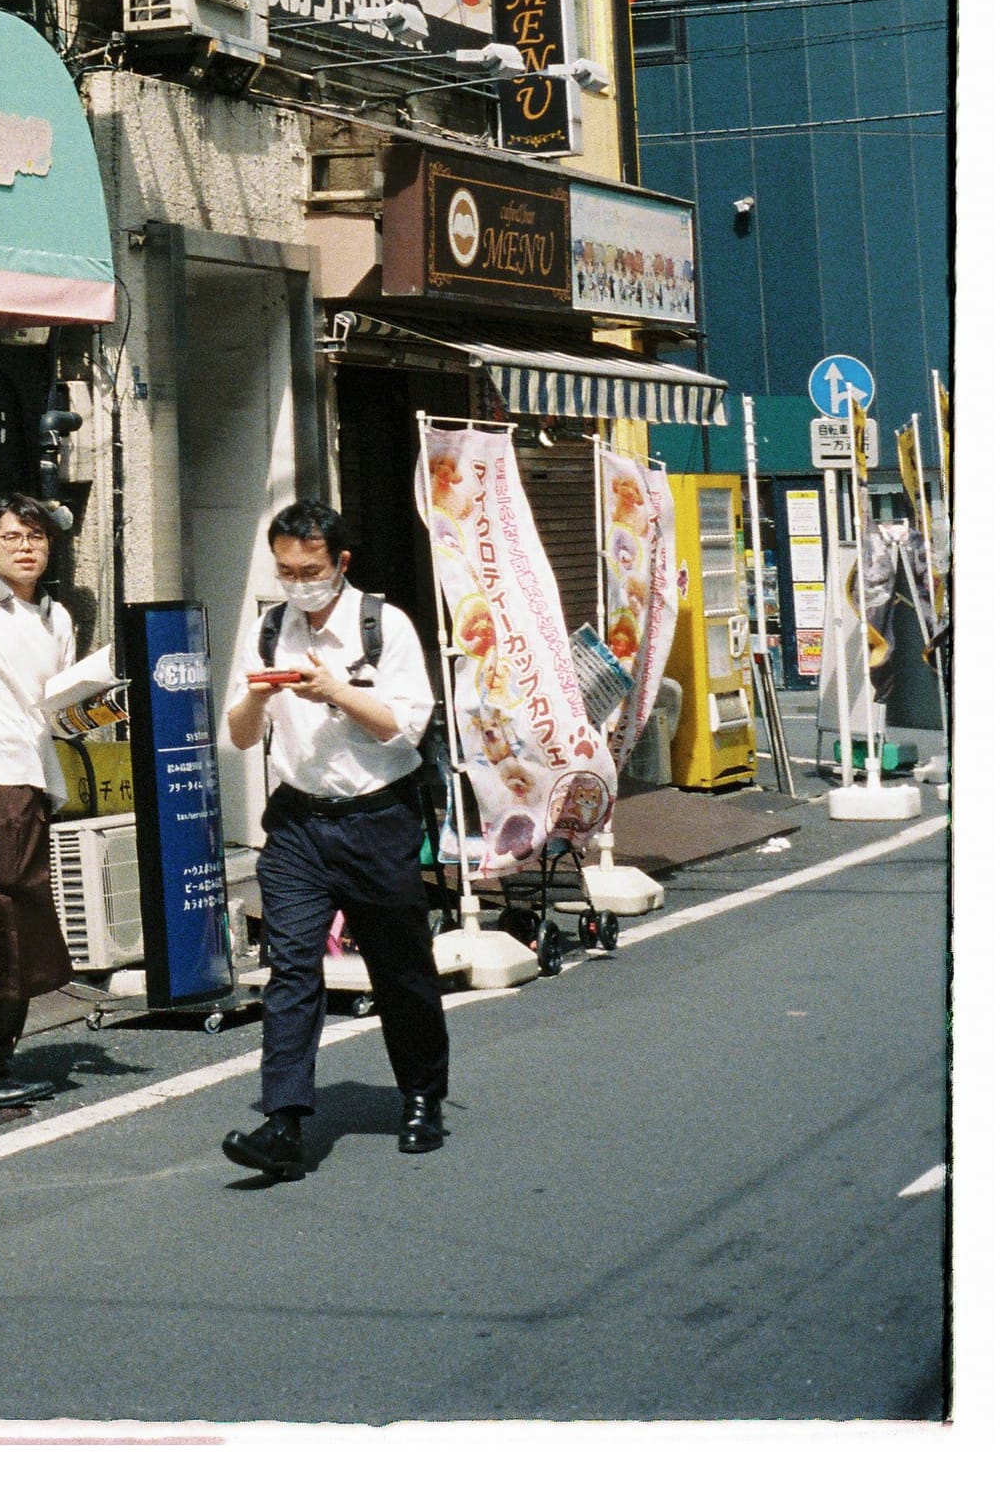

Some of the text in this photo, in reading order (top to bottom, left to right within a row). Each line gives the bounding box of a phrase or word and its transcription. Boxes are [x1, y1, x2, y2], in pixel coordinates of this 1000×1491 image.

[482, 227, 554, 276] MENU
[472, 463, 568, 767] マイクロティーカップカフェ
